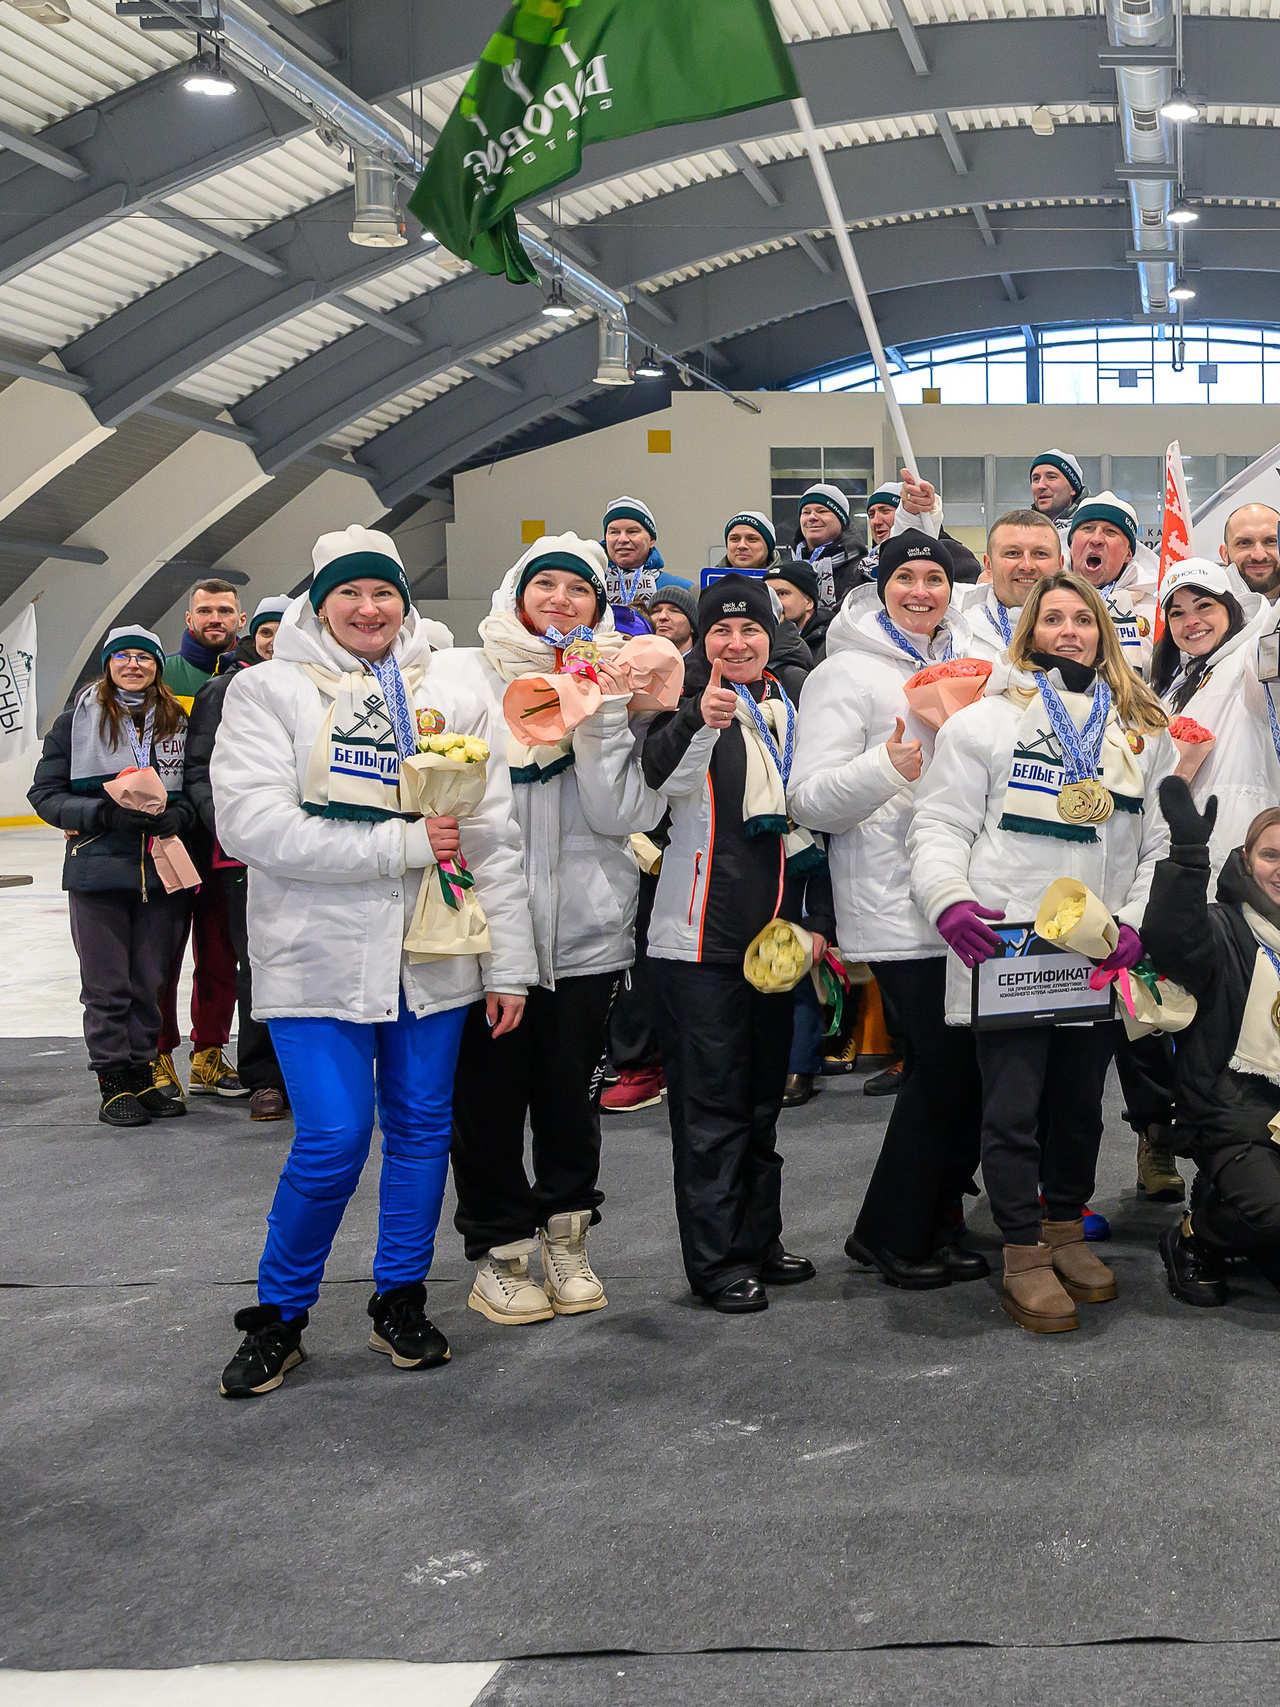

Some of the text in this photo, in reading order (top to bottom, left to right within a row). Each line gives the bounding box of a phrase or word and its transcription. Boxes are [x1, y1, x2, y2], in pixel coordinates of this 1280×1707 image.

[334, 747, 379, 768] БЕЛЫ
[1012, 762, 1055, 784] БЕЛЫЕ
[997, 966, 1092, 987] СЕРТИФИКАТ
